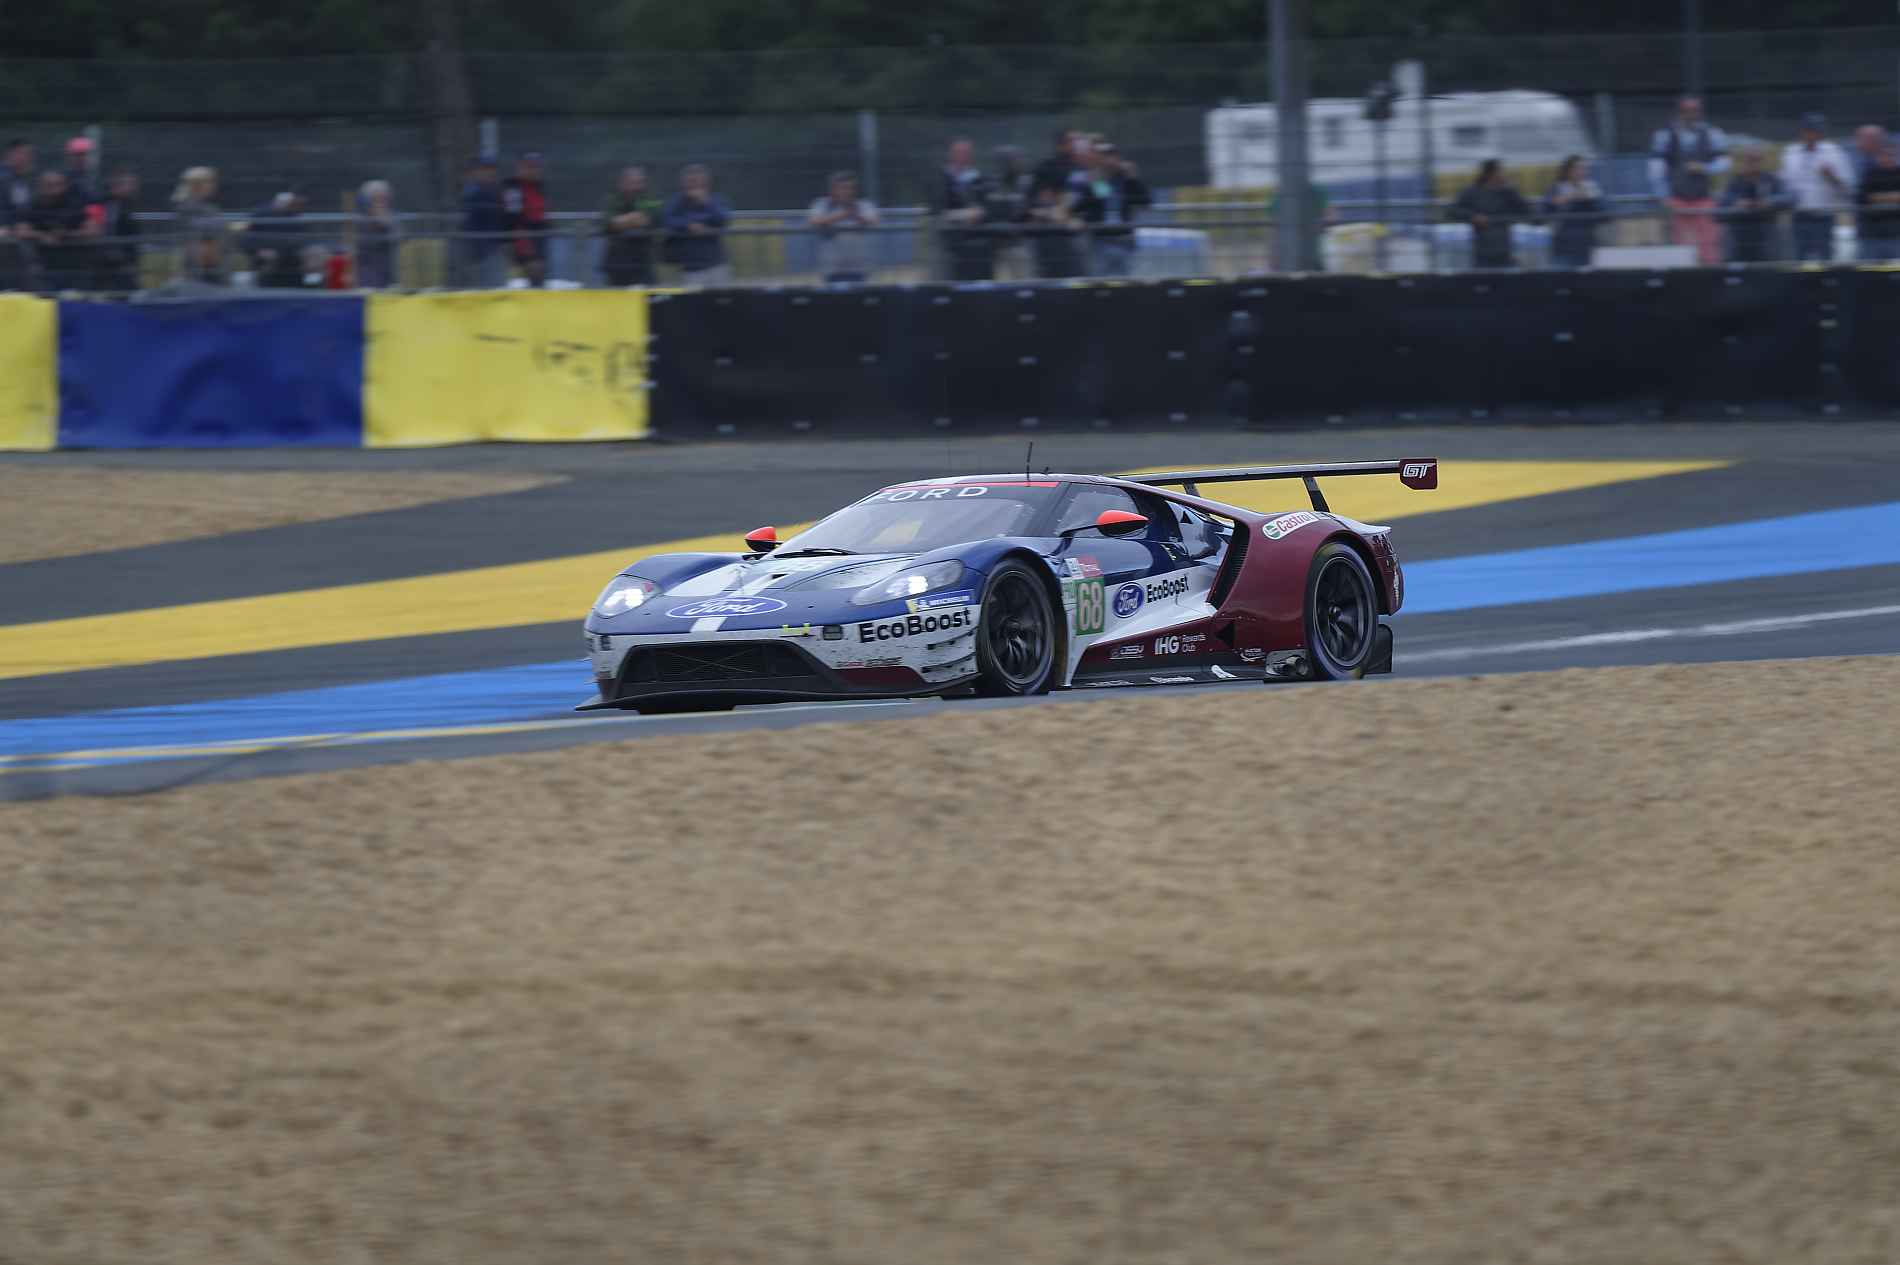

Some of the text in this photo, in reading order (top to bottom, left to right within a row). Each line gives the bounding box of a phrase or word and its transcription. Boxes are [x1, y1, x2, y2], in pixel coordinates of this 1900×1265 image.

[1403, 463, 1427, 478] GT
[871, 486, 988, 502] FORD
[1276, 513, 1313, 532] Castrol
[1146, 575, 1189, 603] EcoBoost
[684, 599, 766, 615] Ford
[1079, 582, 1103, 631] 68
[1118, 589, 1139, 612] Ford
[859, 607, 971, 643] EcoBoost
[1155, 635, 1179, 654] IHG
